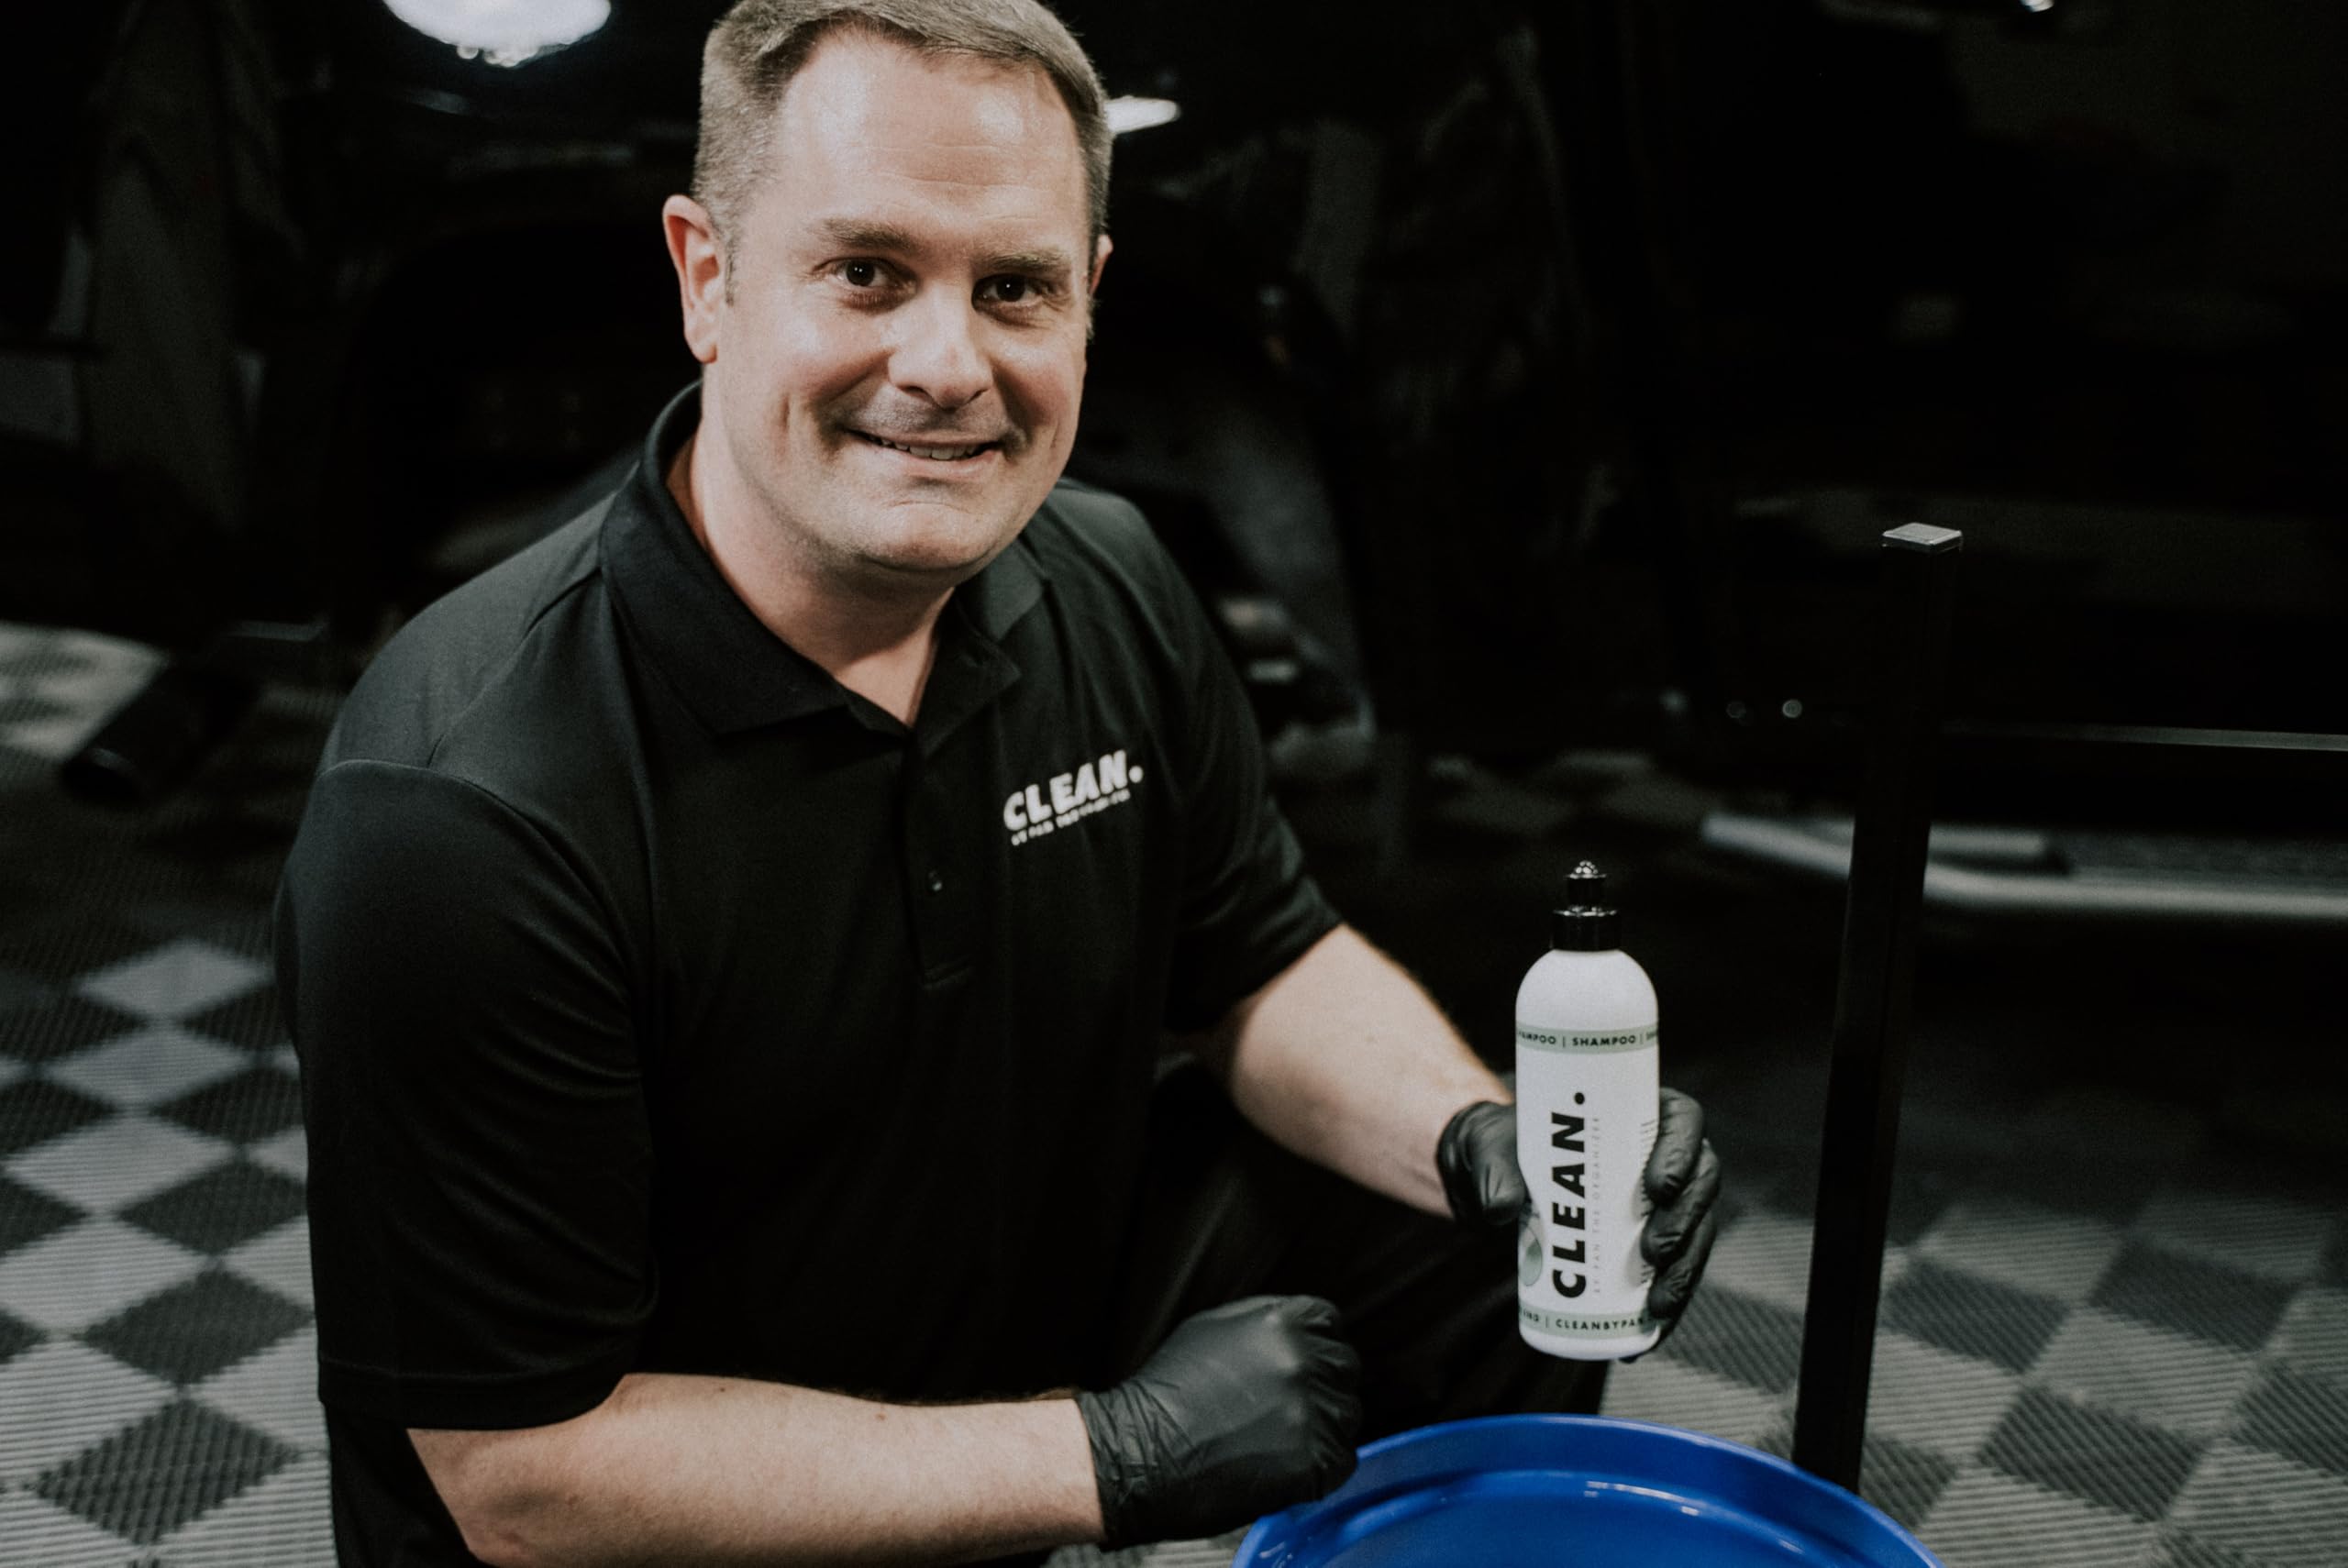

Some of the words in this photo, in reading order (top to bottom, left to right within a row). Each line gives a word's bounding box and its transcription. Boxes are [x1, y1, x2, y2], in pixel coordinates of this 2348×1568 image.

[1003, 749, 1144, 831] CLEAN.
[1572, 1035, 1636, 1046] SHAMPOO
[1551, 1092, 1587, 1298] CLEAN.
